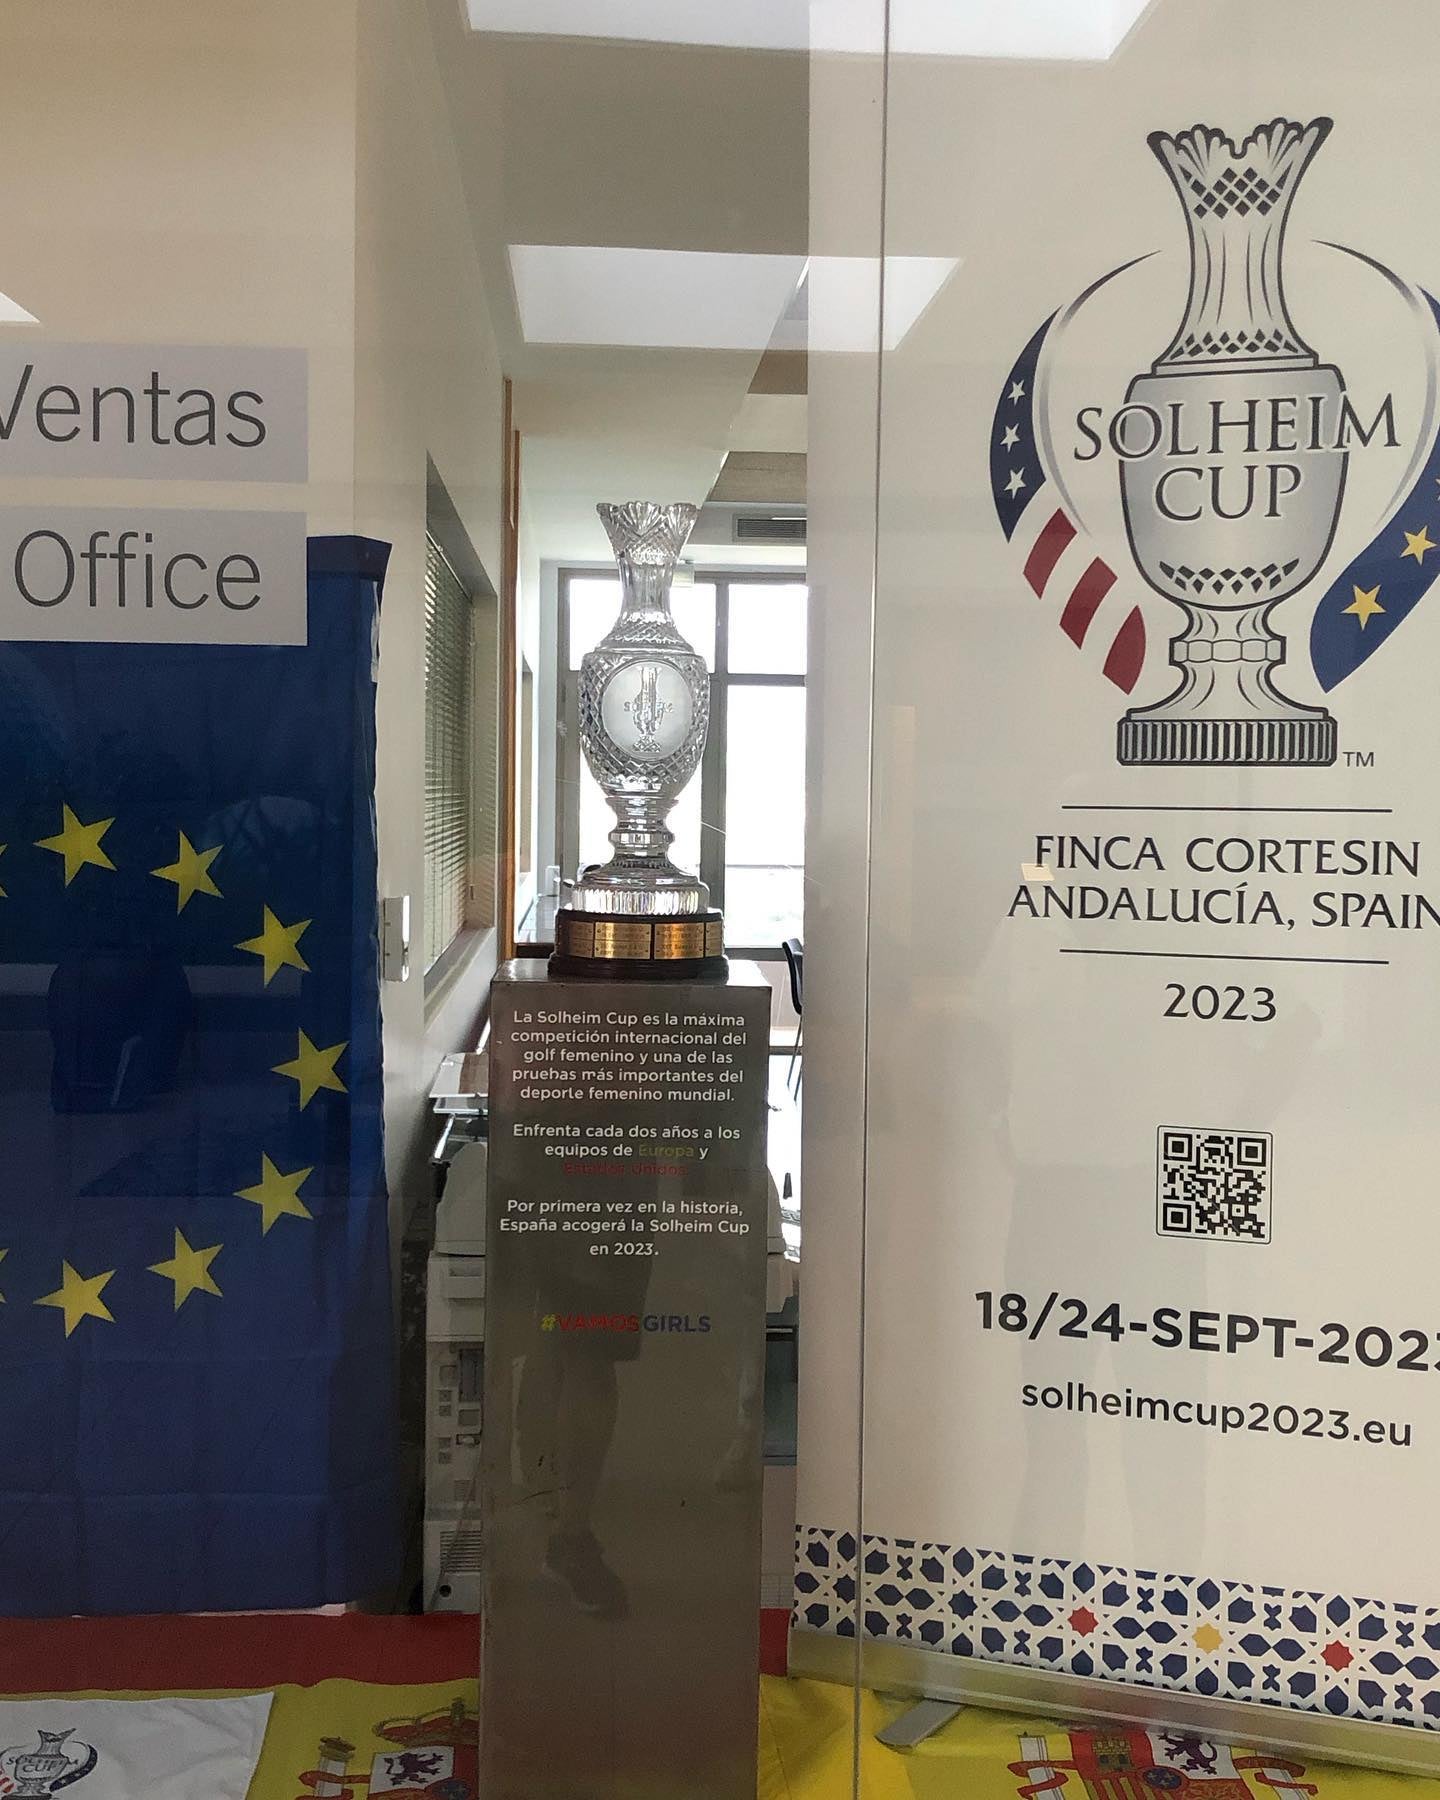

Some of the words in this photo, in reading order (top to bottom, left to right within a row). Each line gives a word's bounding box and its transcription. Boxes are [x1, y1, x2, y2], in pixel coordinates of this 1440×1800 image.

[0, 364, 267, 448] Ventas
[1073, 392, 1401, 462] SOLHEIM
[1155, 463, 1302, 521] CUP
[14, 529, 261, 611] Office
[1342, 751, 1375, 767] TM
[1035, 835, 1166, 871] FINCA
[1186, 837, 1421, 878] CORTESIN
[1007, 881, 1295, 931] ANDALUCÍA,
[1311, 891, 1440, 930] SPAIN
[1163, 983, 1277, 1022] 2023
[513, 1010, 533, 1023] La
[537, 1010, 601, 1024] Solheim
[606, 1012, 638, 1027] Cup
[642, 1014, 660, 1025] es
[665, 1012, 678, 1025] la
[683, 1013, 745, 1026] máxima
[510, 1030, 610, 1044] competición
[615, 1030, 717, 1045] internacional
[722, 1032, 747, 1045] del
[523, 1048, 556, 1063] golf
[560, 1048, 635, 1062] femenino
[639, 1052, 649, 1065] y
[653, 1053, 682, 1063] una
[687, 1050, 707, 1063] de
[711, 1050, 733, 1064] las
[581, 1068, 614, 1081] más
[618, 1068, 714, 1083] importantes
[719, 1070, 744, 1083] del
[520, 1086, 584, 1101] deporte
[588, 1086, 663, 1101] femenino
[667, 1088, 735, 1101] mundial.
[513, 1123, 581, 1137] Enfrenta
[585, 1125, 624, 1138] cada
[628, 1125, 658, 1138] dos
[661, 1125, 699, 1139] años
[703, 1128, 713, 1139] a
[718, 1126, 741, 1139] los
[544, 1143, 608, 1158] equipos
[612, 1143, 633, 1156] de
[638, 1144, 694, 1158] Europa
[699, 1147, 709, 1160] y
[507, 1199, 535, 1212] Por
[539, 1199, 601, 1215] primera
[606, 1202, 633, 1213] vez
[637, 1202, 657, 1213] en
[662, 1200, 675, 1213] la
[680, 1200, 743, 1217] historia,
[500, 1218, 558, 1233] España
[562, 1218, 626, 1234] acogerá
[631, 1218, 645, 1232] la
[649, 1219, 713, 1233] Solheim
[718, 1220, 750, 1236] Cup
[589, 1244, 609, 1256] en
[613, 1242, 659, 1256] 2023.
[975, 1291, 1440, 1372] 18/24-SEPT-202
[1022, 1381, 1412, 1446] solheimcup2023.eu
